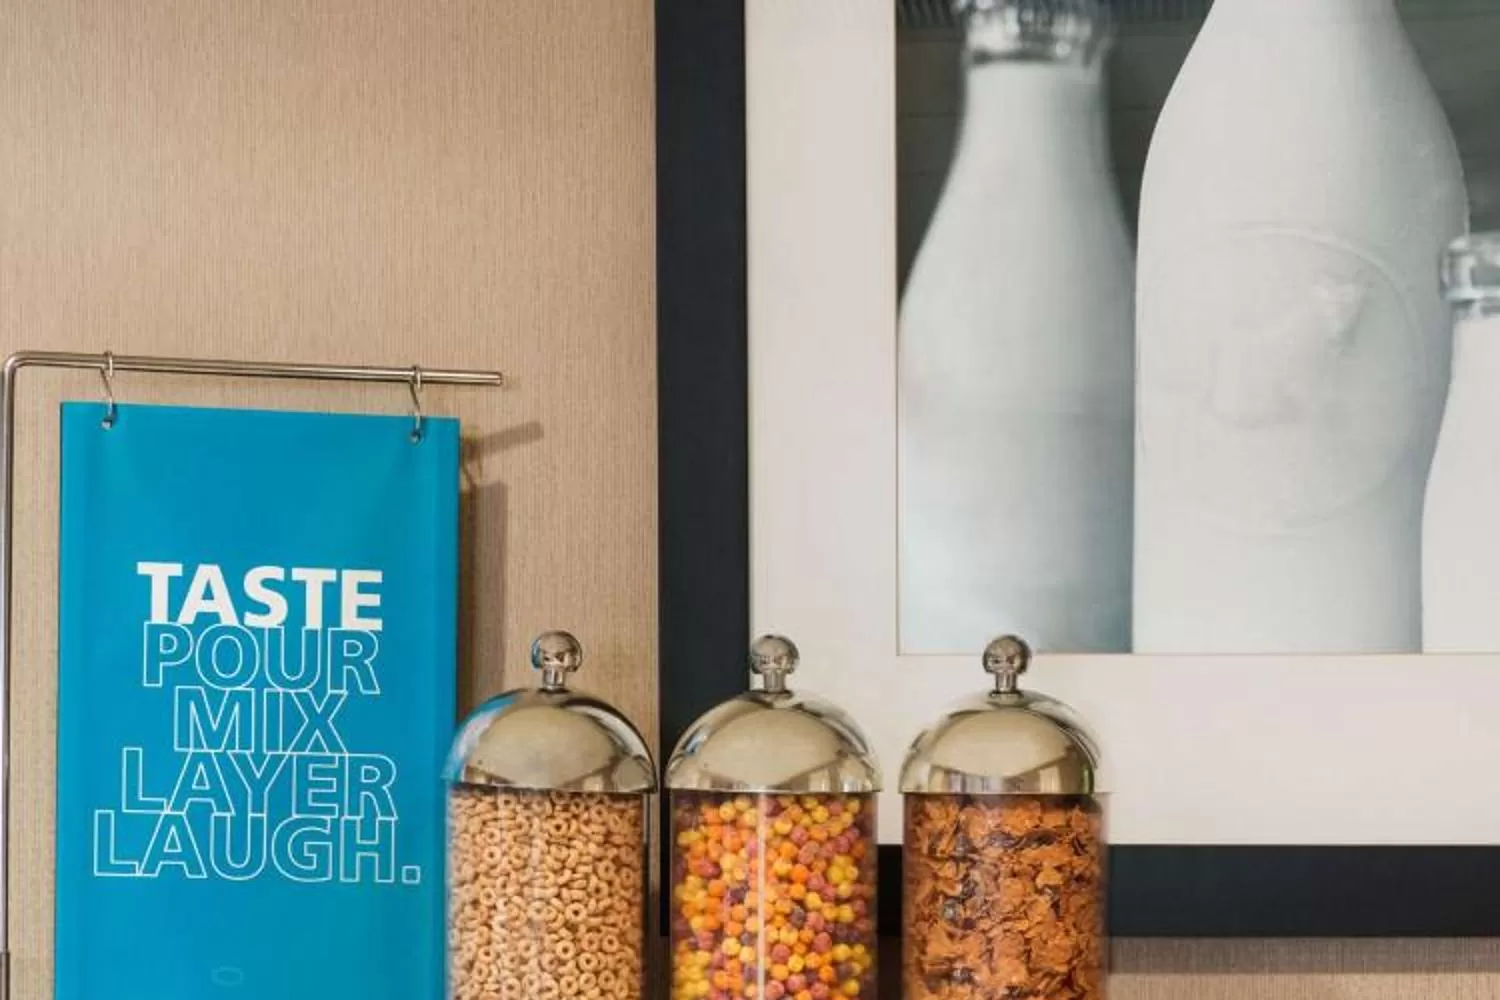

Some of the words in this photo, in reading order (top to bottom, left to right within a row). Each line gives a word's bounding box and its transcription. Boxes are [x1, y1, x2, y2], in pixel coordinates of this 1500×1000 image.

[137, 561, 383, 631] TASTE
[143, 621, 381, 694] POUR
[174, 685, 347, 754] MIX
[122, 747, 399, 821] LAYER
[94, 810, 421, 884] LAUGH.
